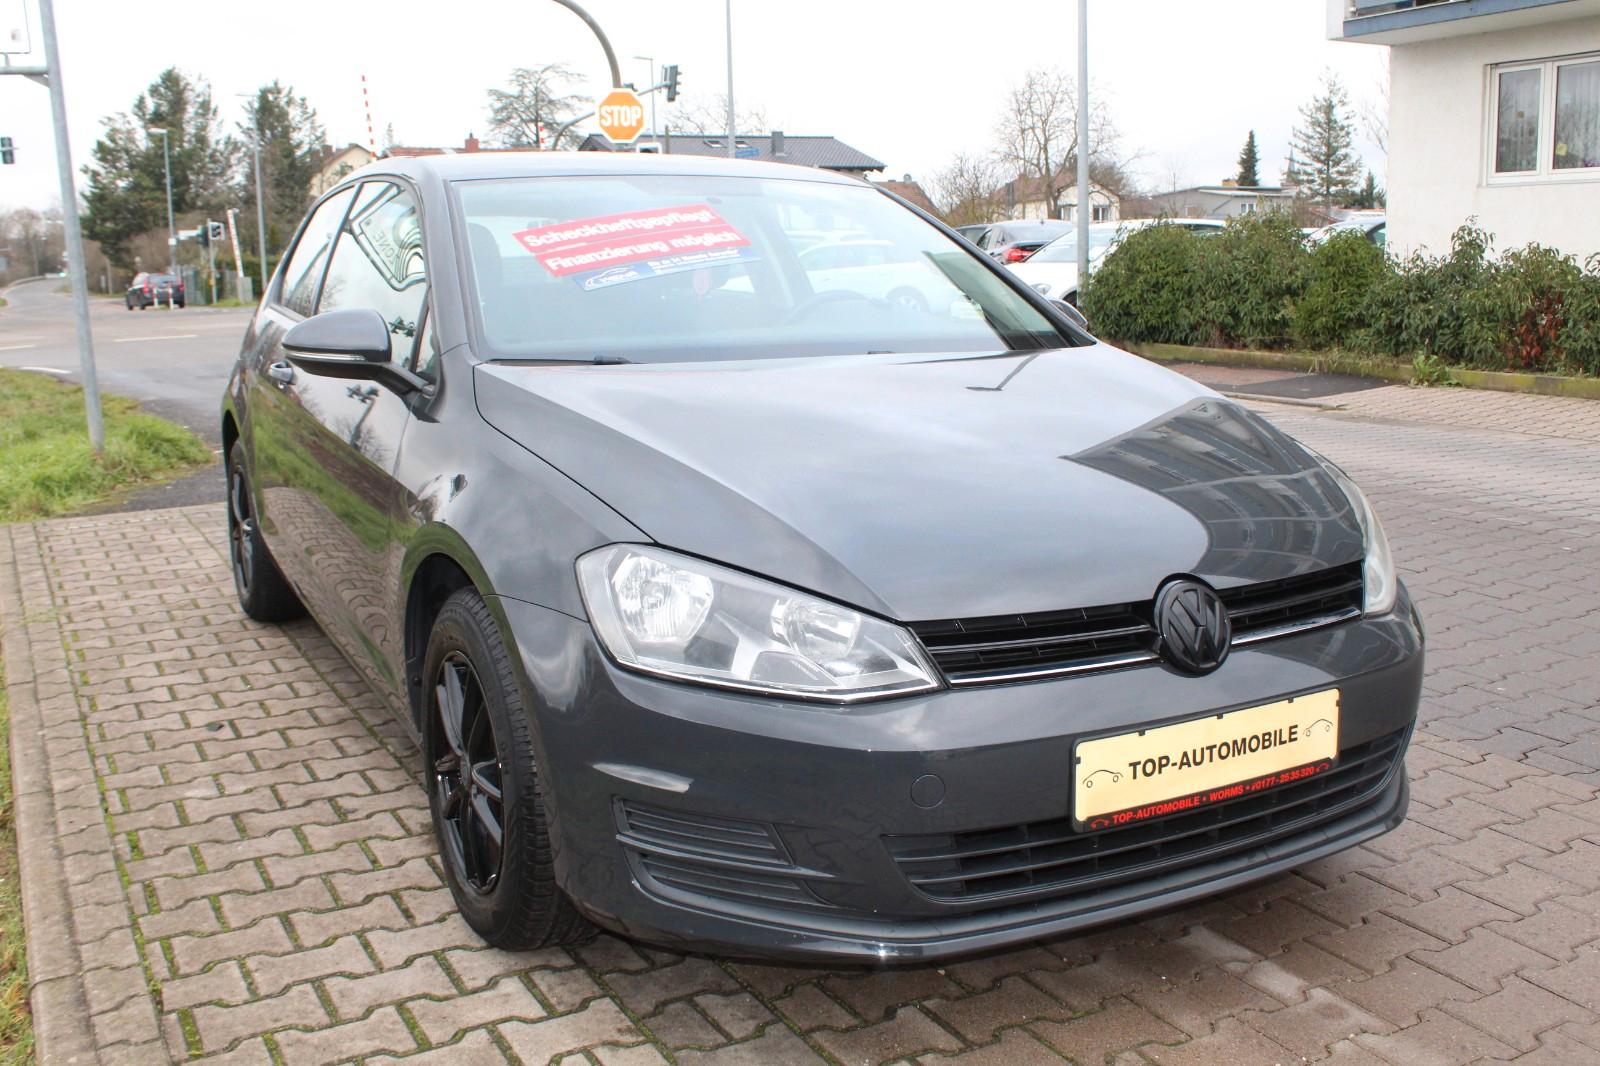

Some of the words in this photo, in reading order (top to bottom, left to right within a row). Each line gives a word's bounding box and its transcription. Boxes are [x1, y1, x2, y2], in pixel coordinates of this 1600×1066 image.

[600, 104, 642, 127] STOP
[523, 209, 716, 248] Scheckheftgepflegt
[544, 240, 670, 271] Finanzierung
[670, 229, 741, 251] möglich
[1128, 724, 1299, 780] TOP-AUTOMOBILE
[1112, 795, 1200, 825] TOP-AUTOMOBILE
[1209, 784, 1245, 802] WORMS
